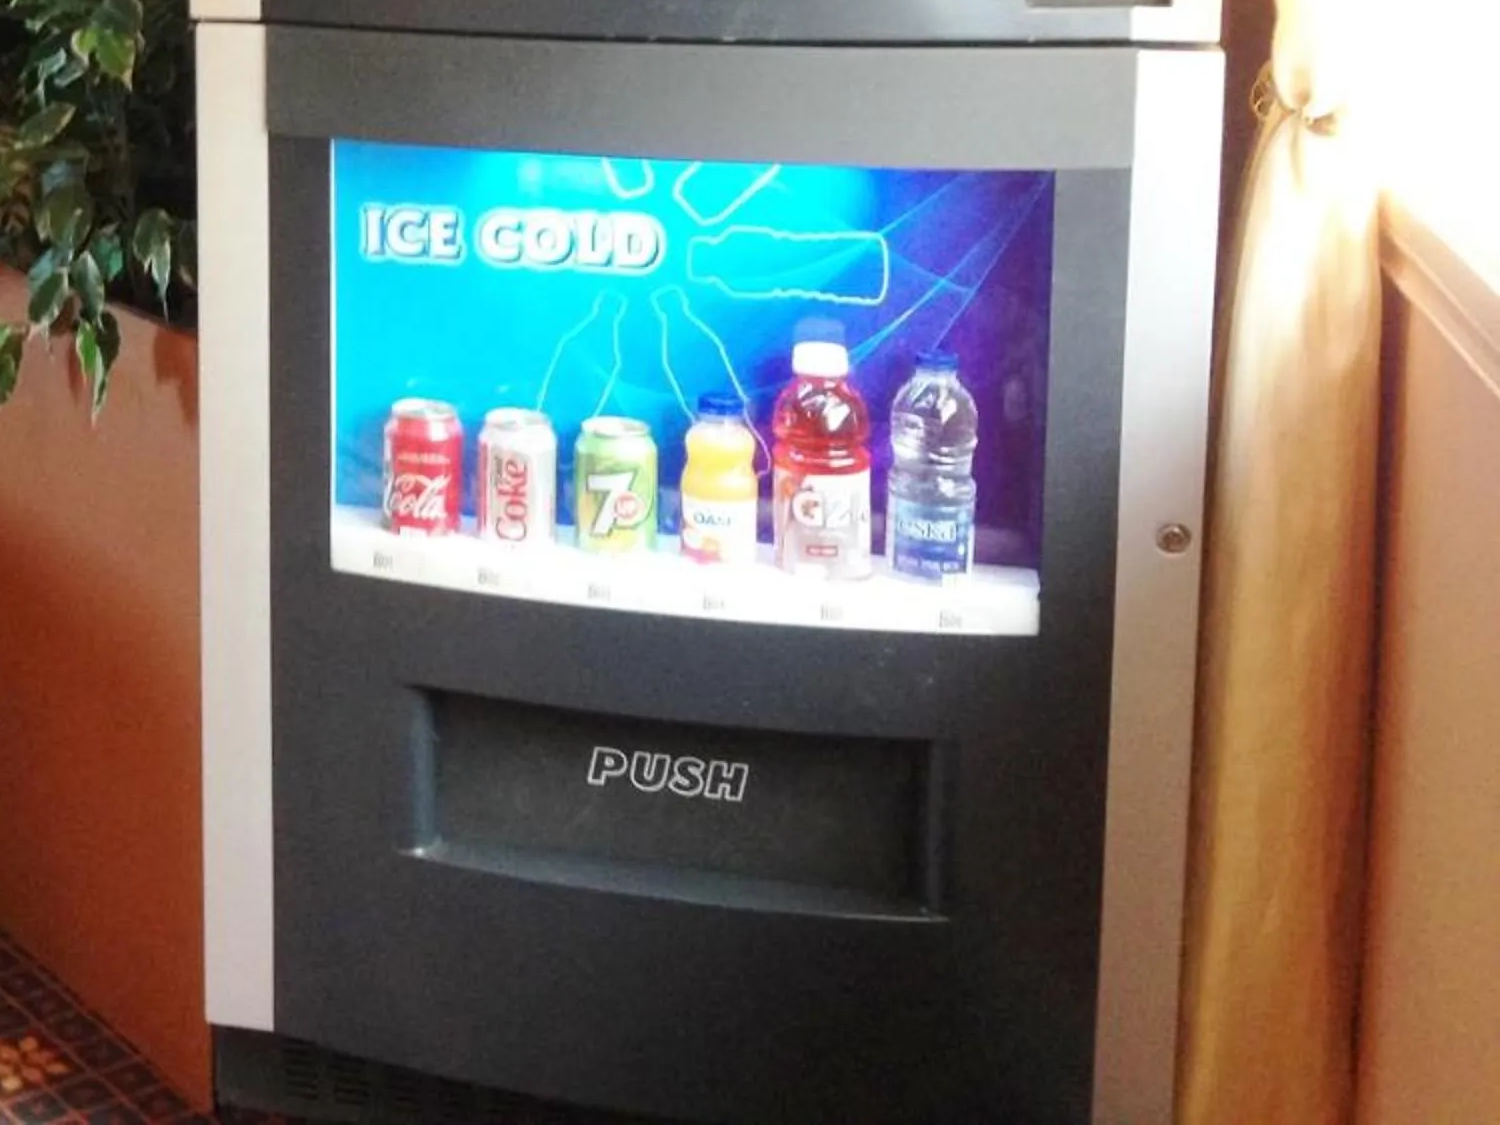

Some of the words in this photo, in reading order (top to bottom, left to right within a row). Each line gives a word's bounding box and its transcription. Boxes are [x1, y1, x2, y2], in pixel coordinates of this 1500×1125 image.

[362, 206, 464, 261] ICE
[479, 207, 663, 270] COLD
[495, 458, 527, 542] Coke
[587, 746, 749, 802] PUSH
